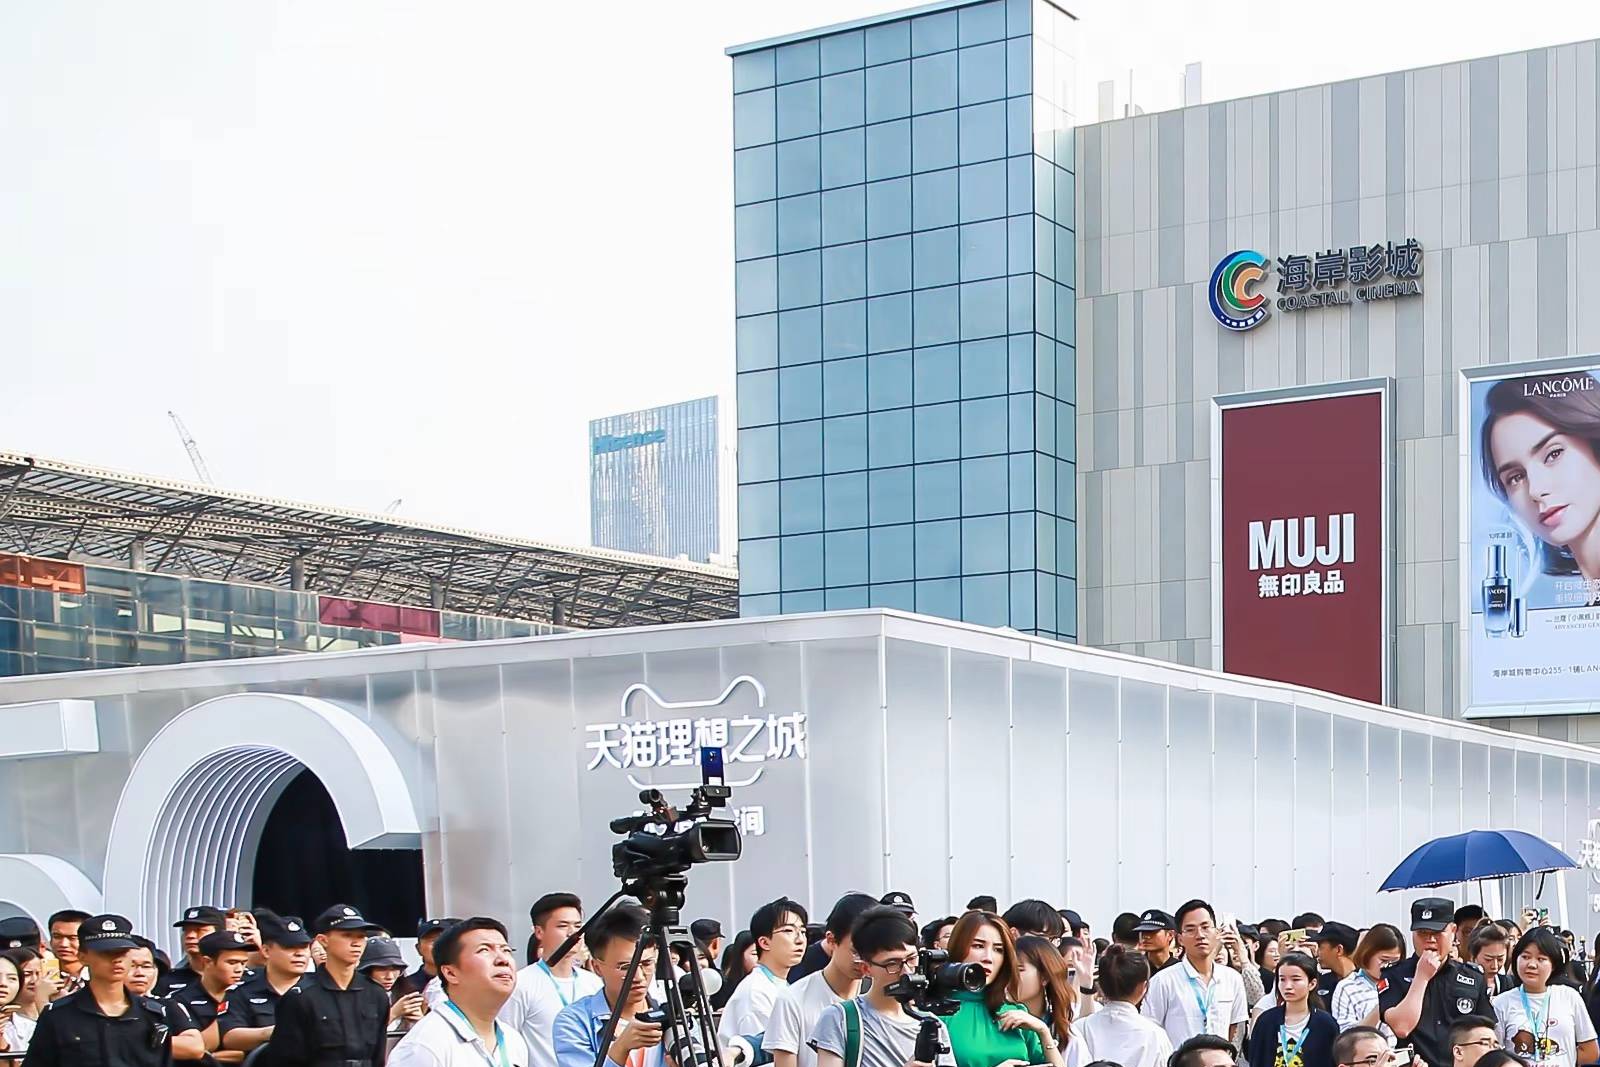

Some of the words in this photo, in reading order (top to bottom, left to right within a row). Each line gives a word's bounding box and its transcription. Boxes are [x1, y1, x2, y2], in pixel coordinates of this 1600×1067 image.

[1277, 238, 1420, 293] 海岸影城
[1277, 291, 1347, 311] COASTAL
[1356, 280, 1421, 301] CINEMA
[1523, 377, 1594, 396] LANCÔME
[1248, 513, 1355, 571] MUJI
[1258, 570, 1345, 598] 無印良品
[585, 711, 808, 770] 天猫理想之城
